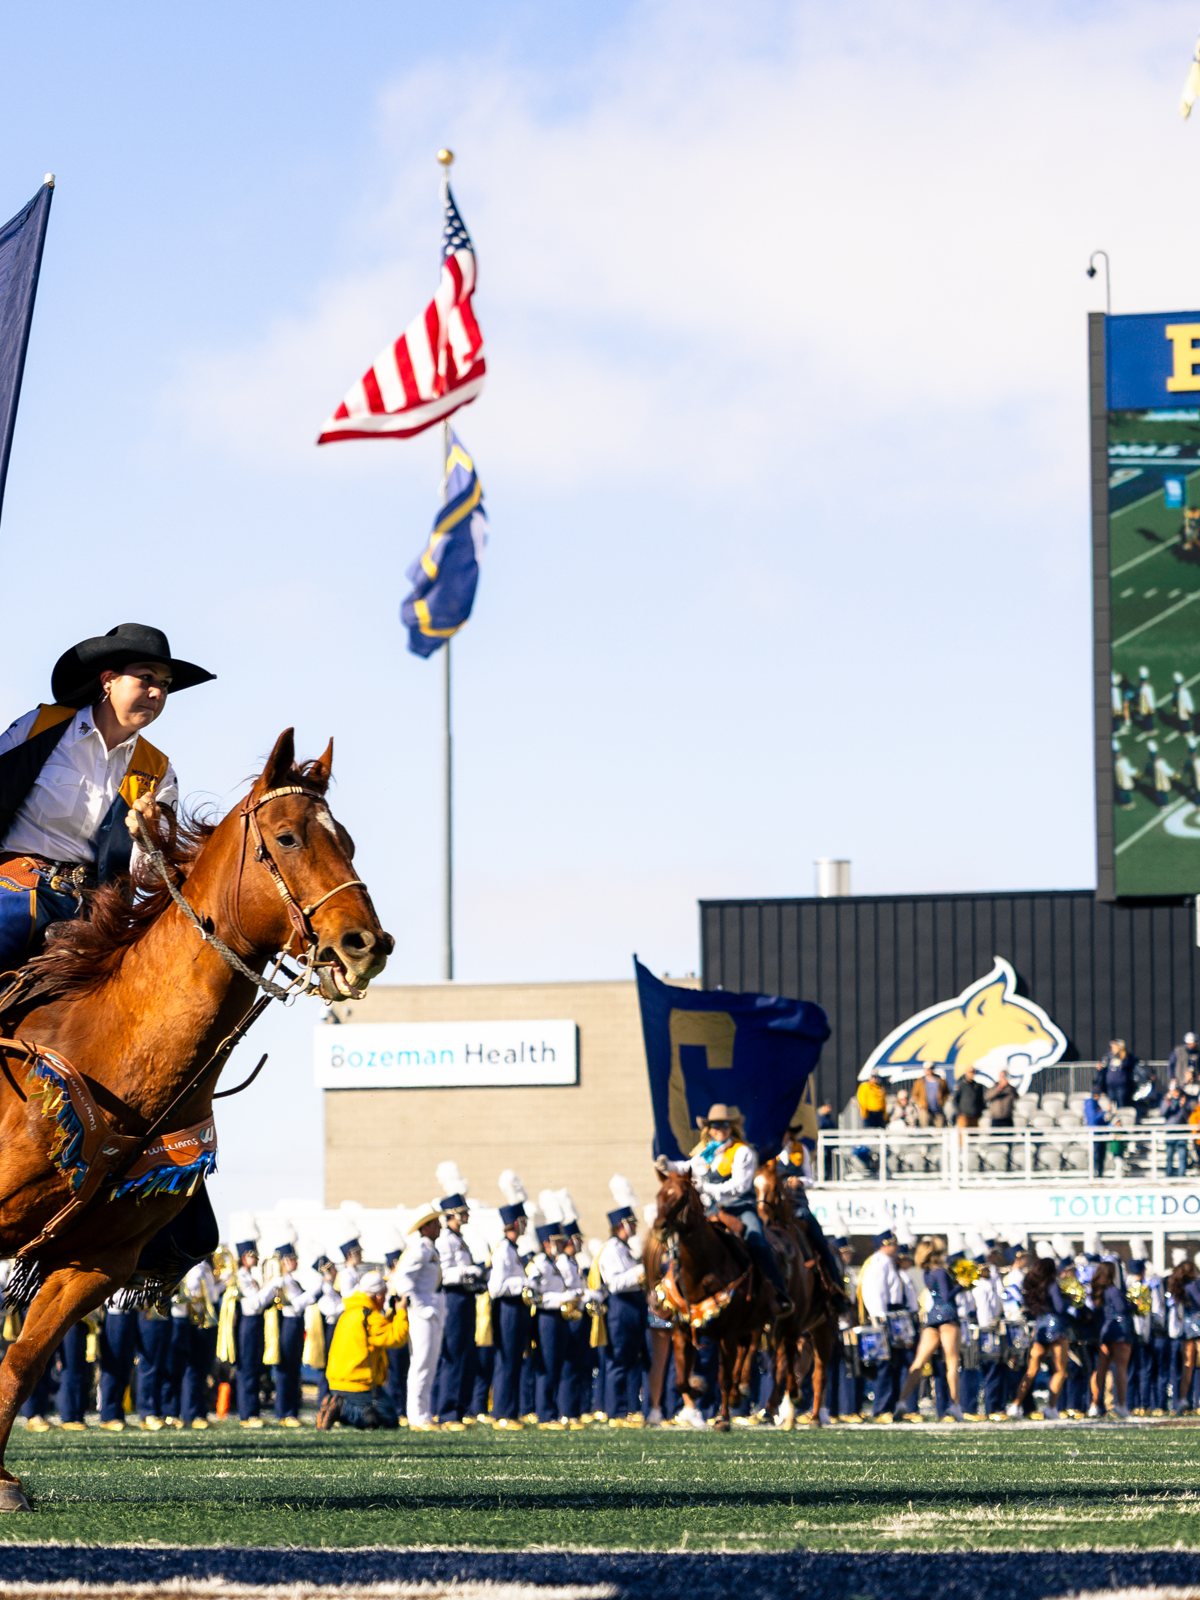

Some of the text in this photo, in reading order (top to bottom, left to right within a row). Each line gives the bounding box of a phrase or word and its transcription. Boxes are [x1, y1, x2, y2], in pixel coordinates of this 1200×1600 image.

[331, 1041, 556, 1068] Bozeman Health
[69, 1077, 97, 1131] WILLIAMS
[147, 1137, 199, 1156] WILLIAMS
[837, 1199, 915, 1218] Helth
[1049, 1195, 1200, 1216] TOUCHDO
